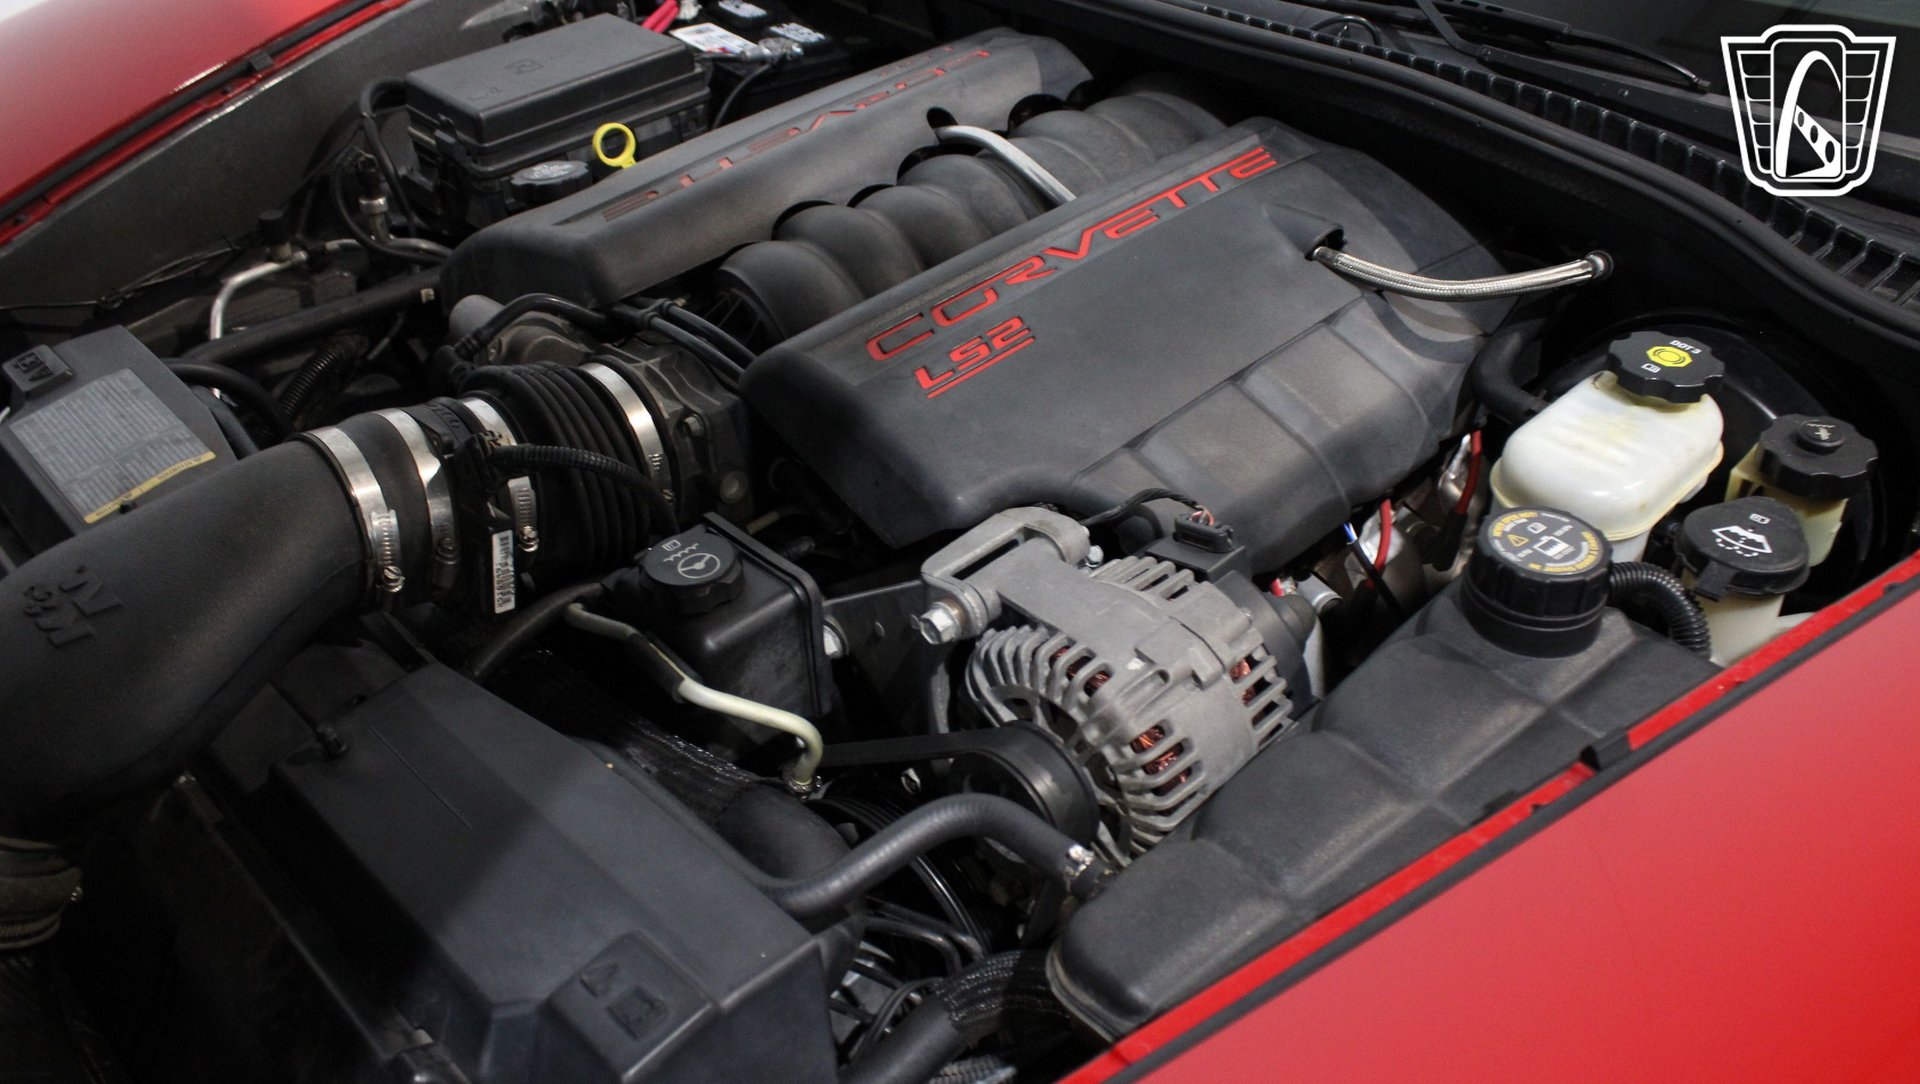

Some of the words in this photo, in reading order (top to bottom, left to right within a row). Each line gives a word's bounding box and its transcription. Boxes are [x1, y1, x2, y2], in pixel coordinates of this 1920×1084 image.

[866, 146, 1278, 361] CORVETTE
[913, 315, 1033, 391] LS2
[1669, 339, 1693, 351] DOT
[1691, 346, 1702, 354] 3
